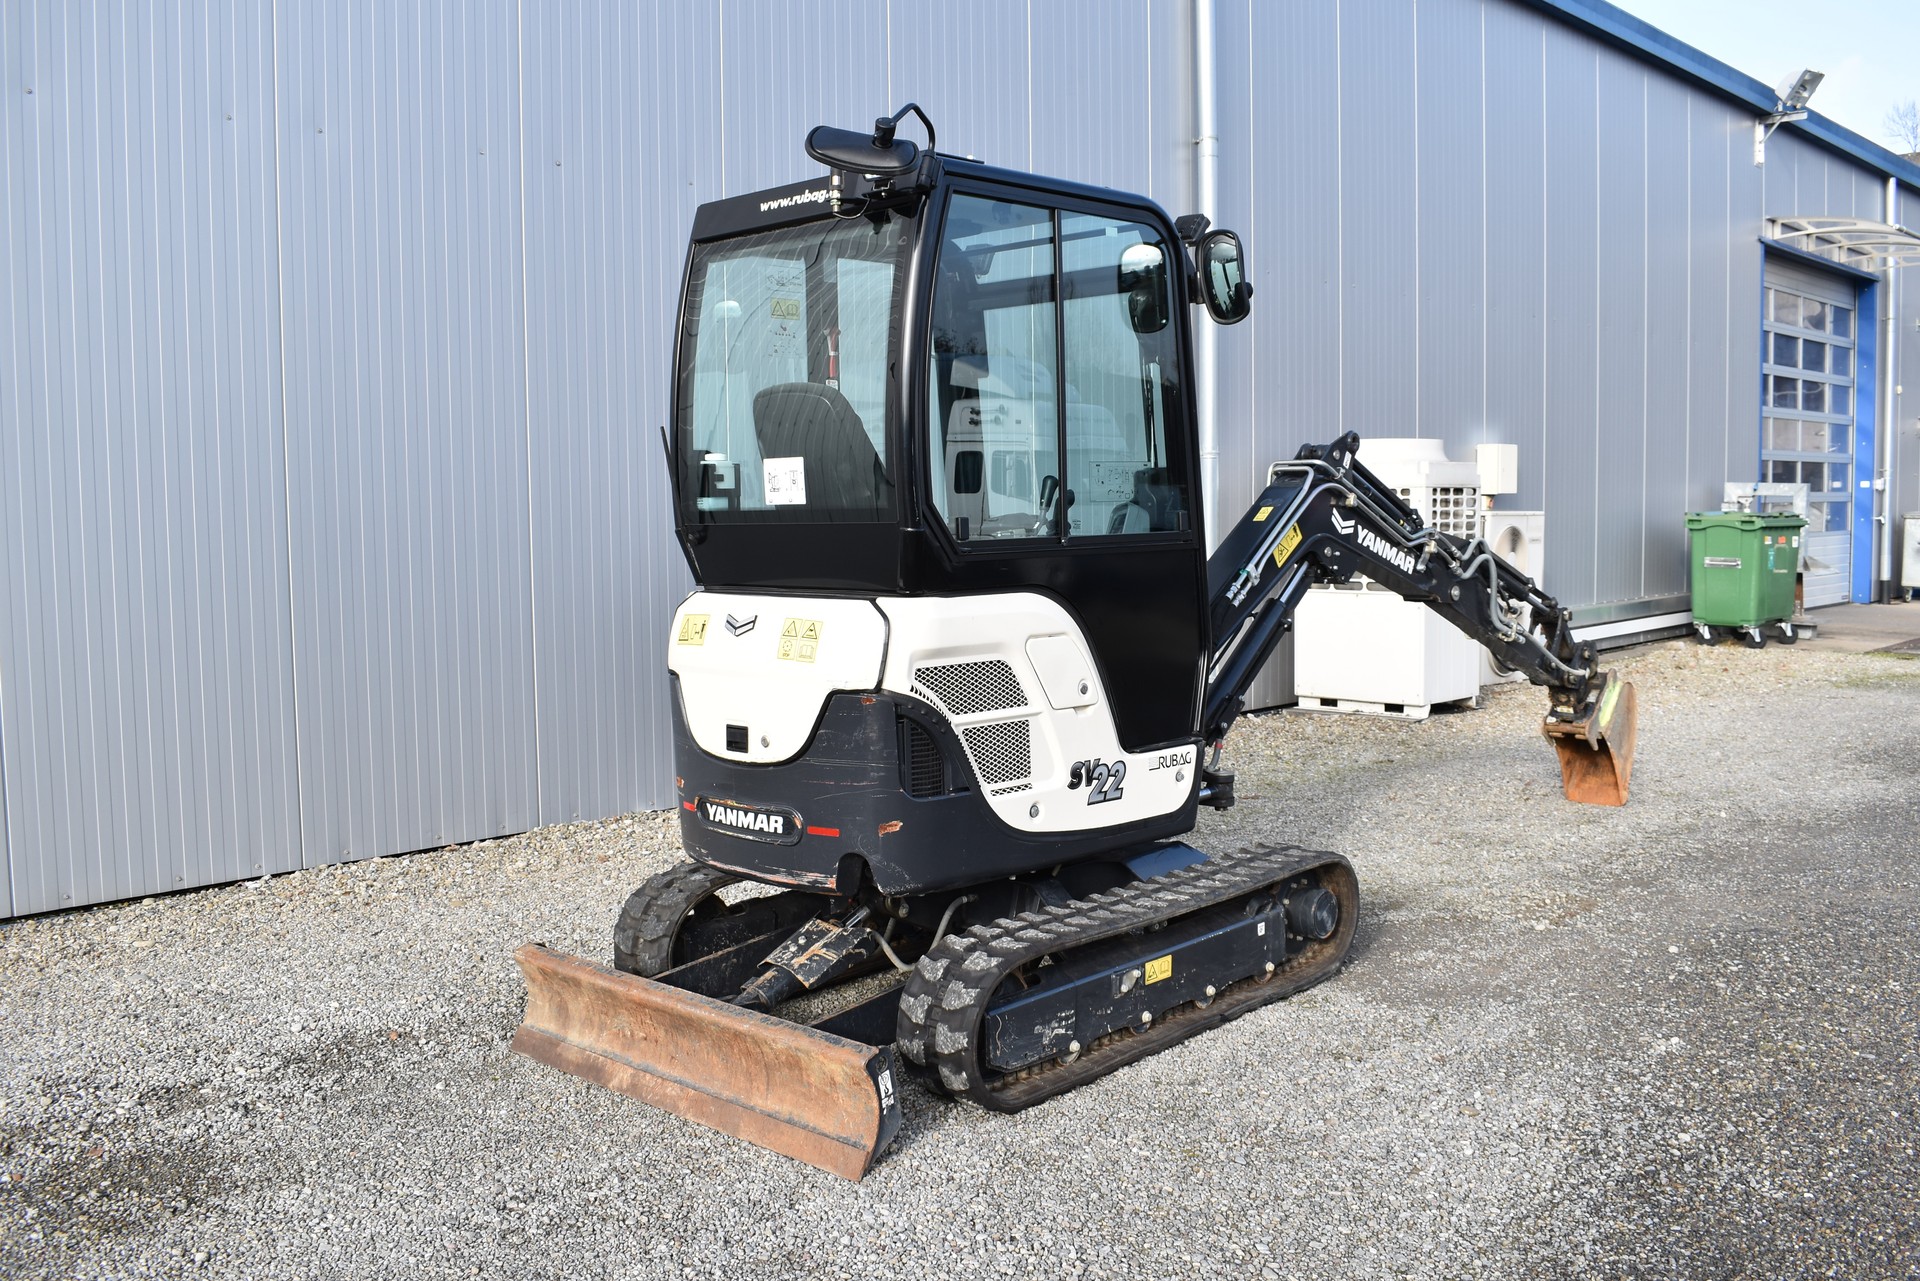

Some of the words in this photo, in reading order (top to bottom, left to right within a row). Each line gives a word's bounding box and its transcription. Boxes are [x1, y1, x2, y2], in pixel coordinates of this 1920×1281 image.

[760, 189, 840, 212] www.rubag.
[1357, 524, 1416, 575] YANMAR
[1158, 752, 1192, 769] RUBAG
[1067, 758, 1126, 806] SV22
[706, 803, 783, 834] YANMAR
